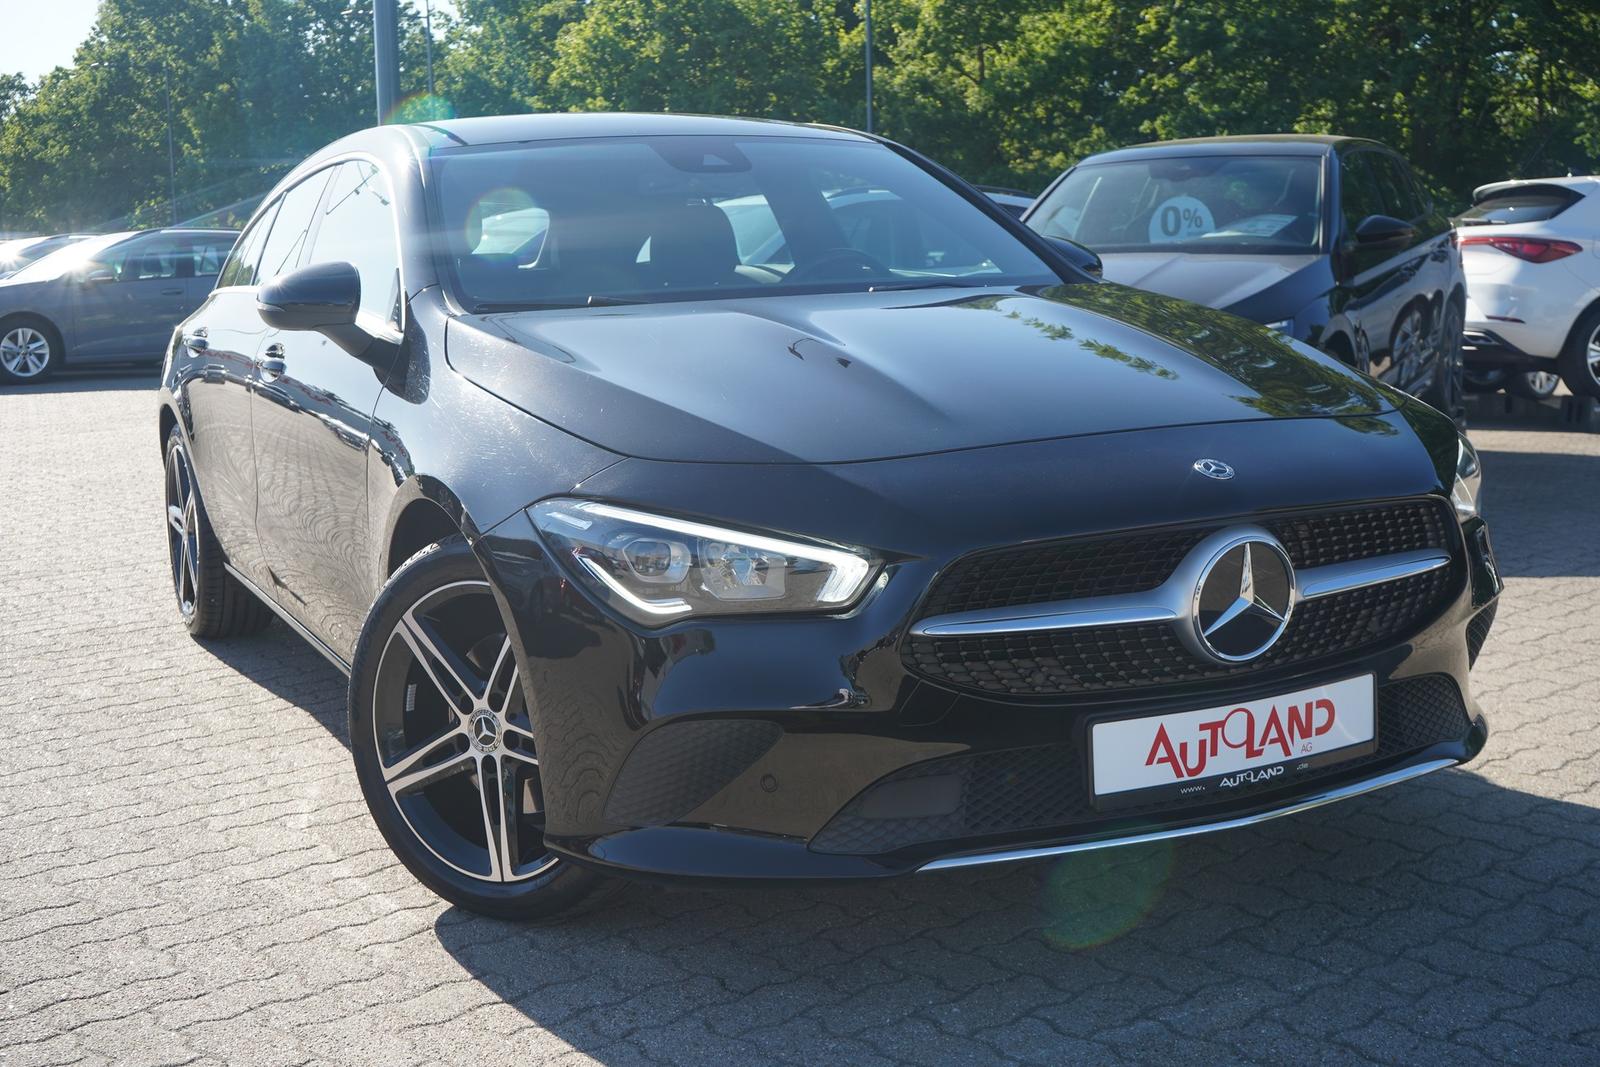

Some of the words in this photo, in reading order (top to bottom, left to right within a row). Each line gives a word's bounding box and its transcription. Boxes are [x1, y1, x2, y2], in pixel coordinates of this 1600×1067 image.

[1160, 206, 1203, 237] 0%
[1144, 698, 1336, 779] AUTOLAND
[1300, 742, 1313, 753] AG
[1180, 784, 1206, 794] www.
[1219, 765, 1285, 788] AUTOLAND
[1296, 762, 1309, 771] .de
